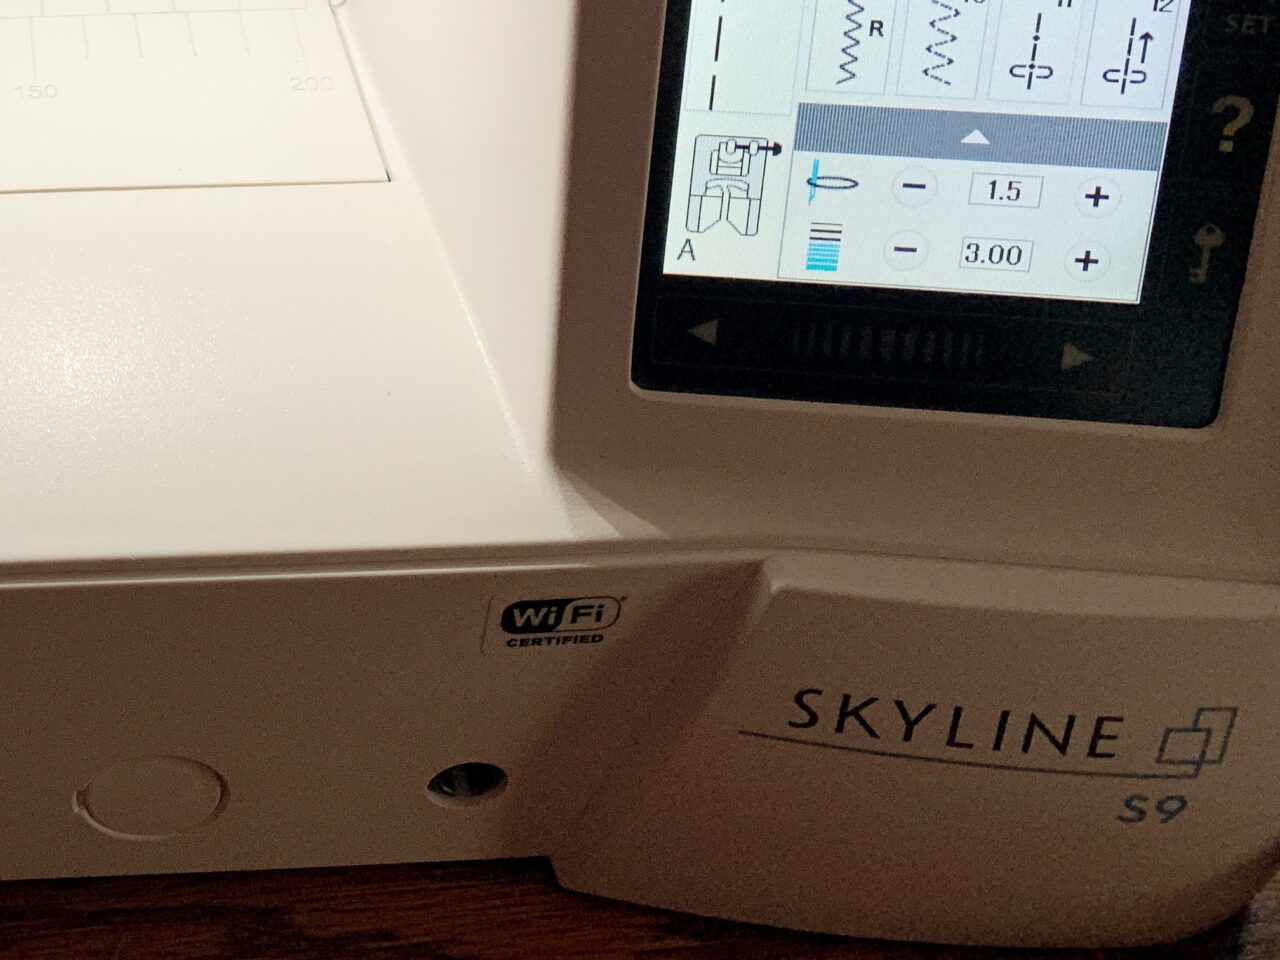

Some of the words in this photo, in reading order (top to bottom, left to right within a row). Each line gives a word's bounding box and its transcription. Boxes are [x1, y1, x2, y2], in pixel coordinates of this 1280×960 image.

[870, 20, 884, 37] R
[1226, 14, 1274, 33] SET
[15, 84, 58, 99] 150
[290, 76, 334, 91] 200
[987, 181, 1021, 202] 1.5
[677, 240, 696, 261] A
[964, 244, 1022, 266] 3.00
[507, 633, 604, 647] CERTIFIED
[788, 689, 1124, 759] SKYLINE
[1117, 795, 1188, 823] S9
